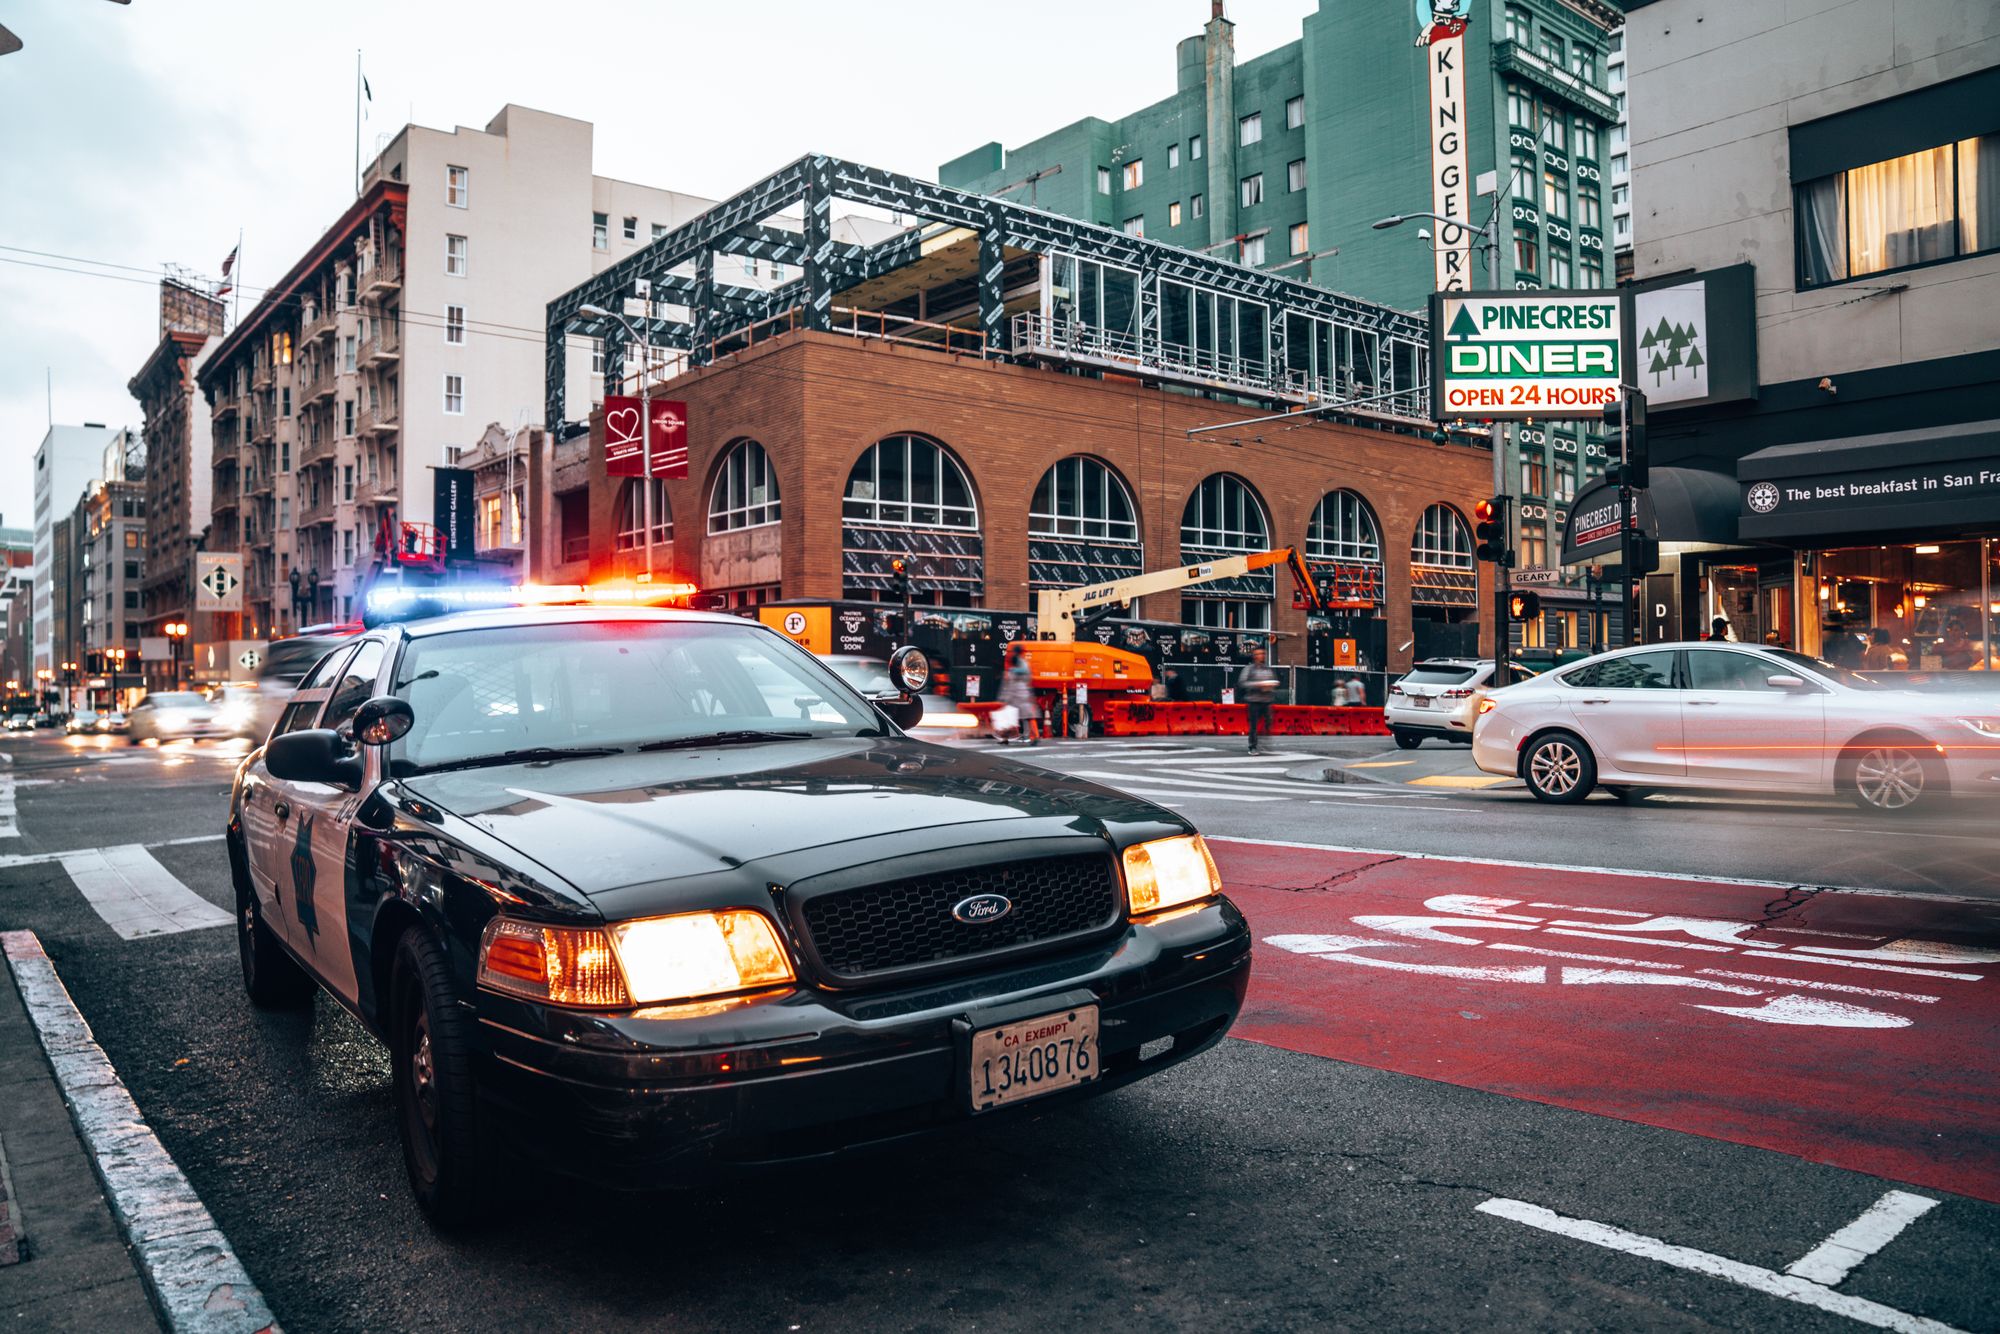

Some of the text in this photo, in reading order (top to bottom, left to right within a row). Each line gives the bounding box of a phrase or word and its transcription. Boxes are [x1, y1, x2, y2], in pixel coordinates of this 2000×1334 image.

[1438, 47, 1458, 155] KING
[1482, 305, 1615, 329] PINECREST
[1451, 345, 1614, 373] DINER
[1449, 385, 1616, 406] OPEN 24 HOURS
[1786, 489, 1811, 501] The
[1816, 486, 1845, 499] best
[1850, 481, 1918, 496] breakfast
[1923, 477, 1938, 490] in
[1943, 474, 1973, 488] San
[1575, 497, 1637, 532] PINECREST DIR
[1516, 573, 1552, 582] GEARY
[1083, 587, 1114, 602] JLG LIFT
[840, 635, 865, 643] COMING
[969, 899, 998, 917] Ford
[1004, 1022, 1068, 1048] CA EXEMPT
[981, 1035, 1091, 1096] 1340876
